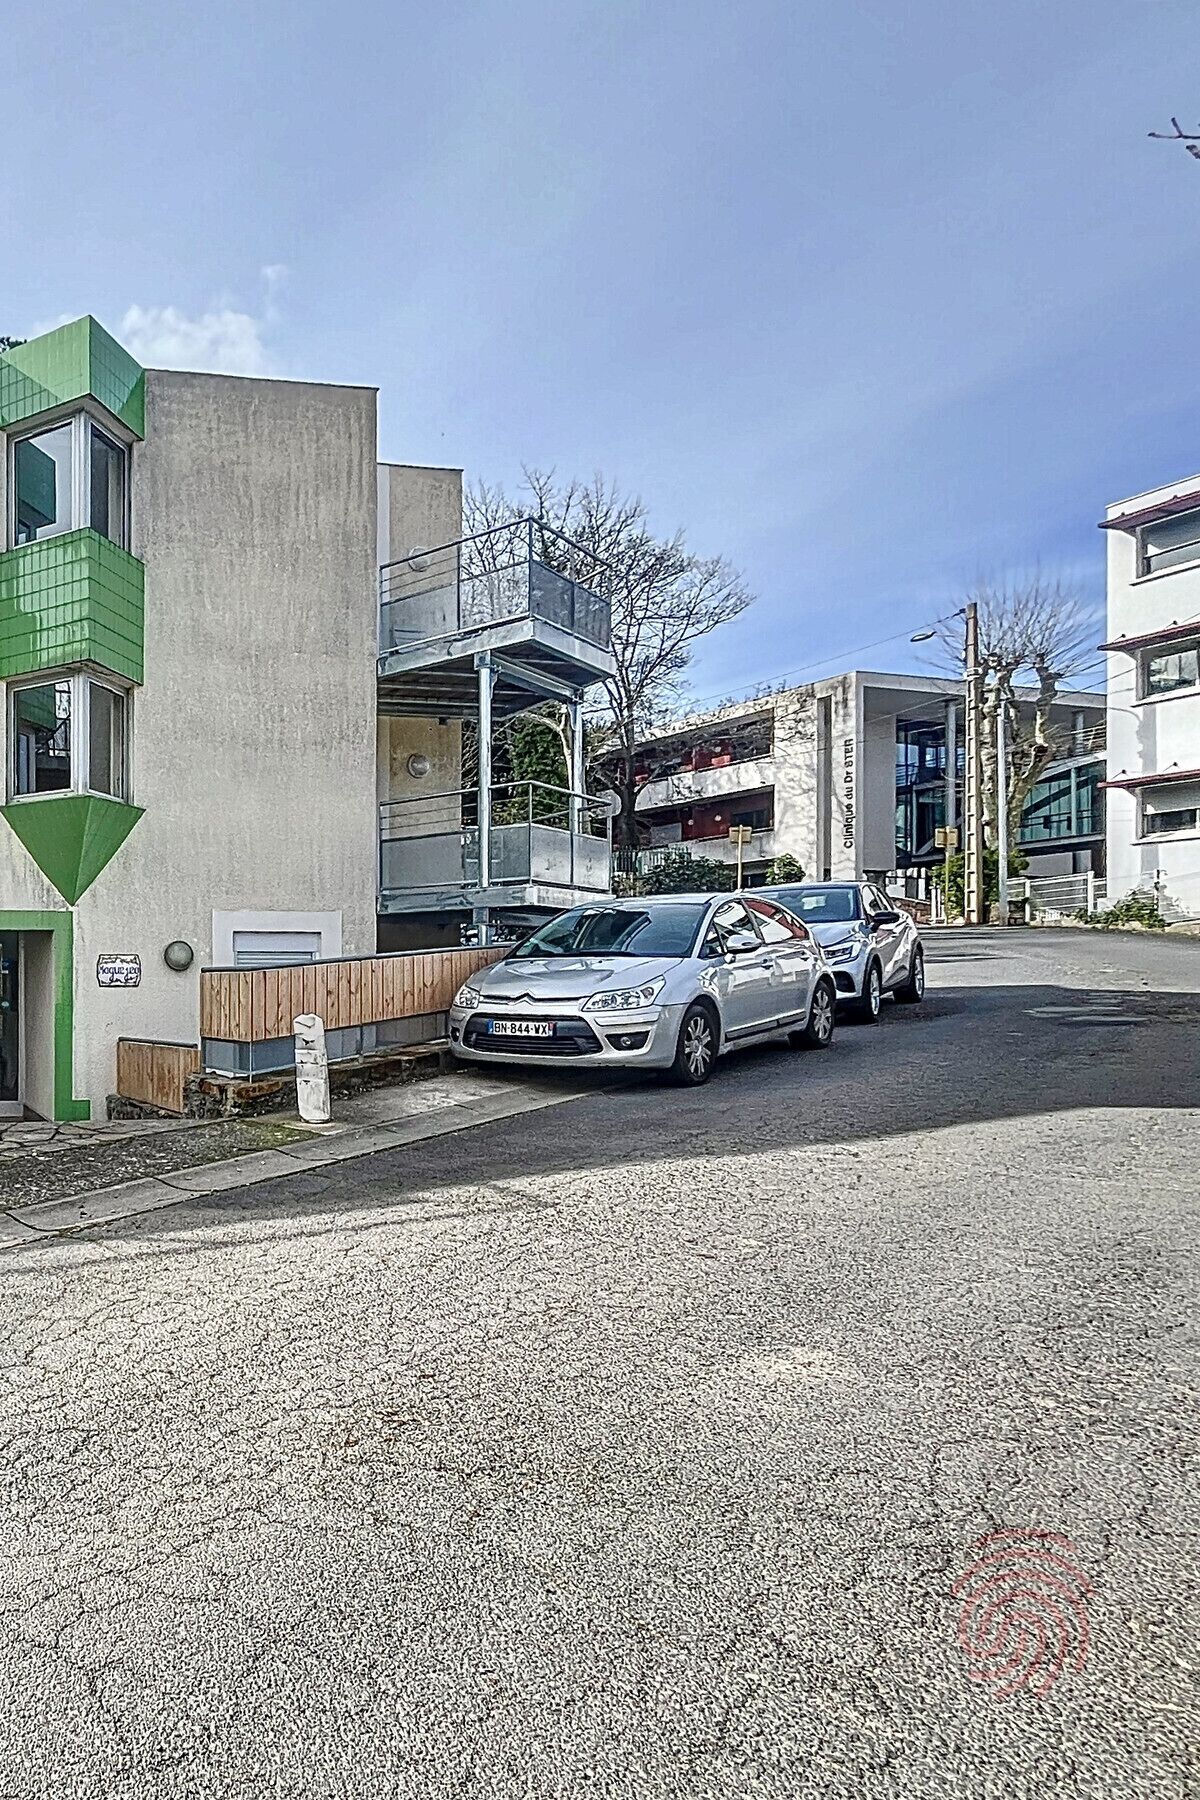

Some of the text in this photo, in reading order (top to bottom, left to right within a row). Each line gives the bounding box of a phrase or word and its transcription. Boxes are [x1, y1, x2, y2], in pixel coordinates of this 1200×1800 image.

[844, 771, 854, 784] Dr
[844, 786, 854, 800] du
[844, 803, 855, 849] Clinique
[494, 1022, 548, 1035] BN-844-VX
